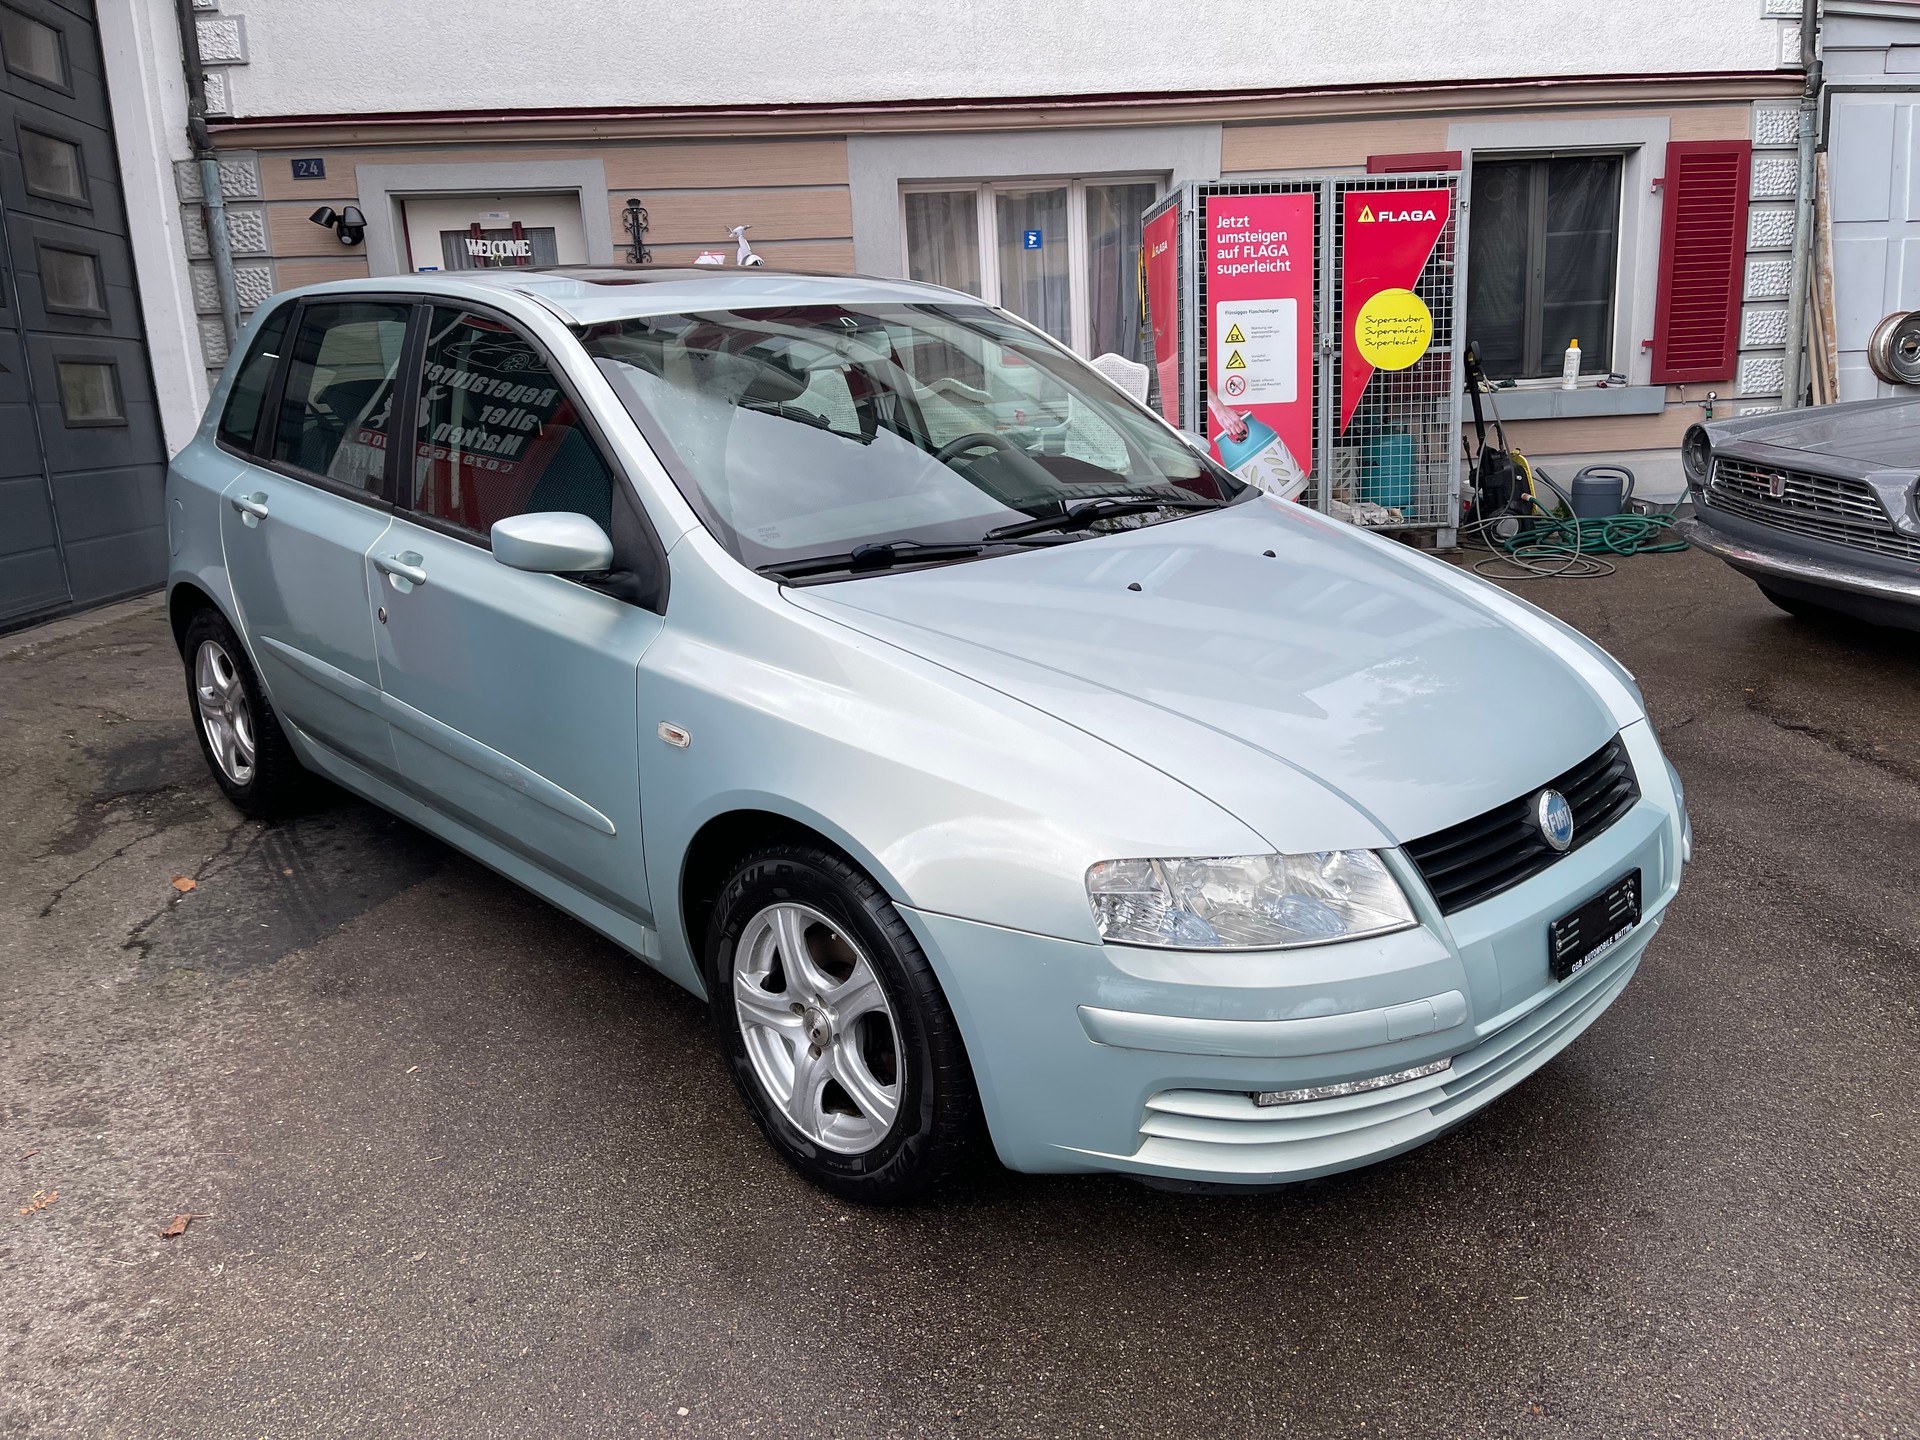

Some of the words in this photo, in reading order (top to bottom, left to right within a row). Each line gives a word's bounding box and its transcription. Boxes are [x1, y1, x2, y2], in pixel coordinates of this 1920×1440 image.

[298, 161, 319, 176] 24
[1216, 215, 1250, 228] Jetzt
[1378, 210, 1436, 222] FLAGA
[1217, 229, 1288, 245] umsteigen
[465, 238, 531, 257] WELCOME
[1217, 245, 1239, 259] auf
[1243, 244, 1289, 258] FLAGA
[1217, 259, 1291, 277] superleicht
[1365, 314, 1424, 327] Supersauber
[1365, 325, 1426, 338] Supereinfach
[1365, 336, 1418, 349] Superleicht
[1548, 806, 1570, 833] FIAT
[1584, 936, 1613, 964] AUTOMOBILE
